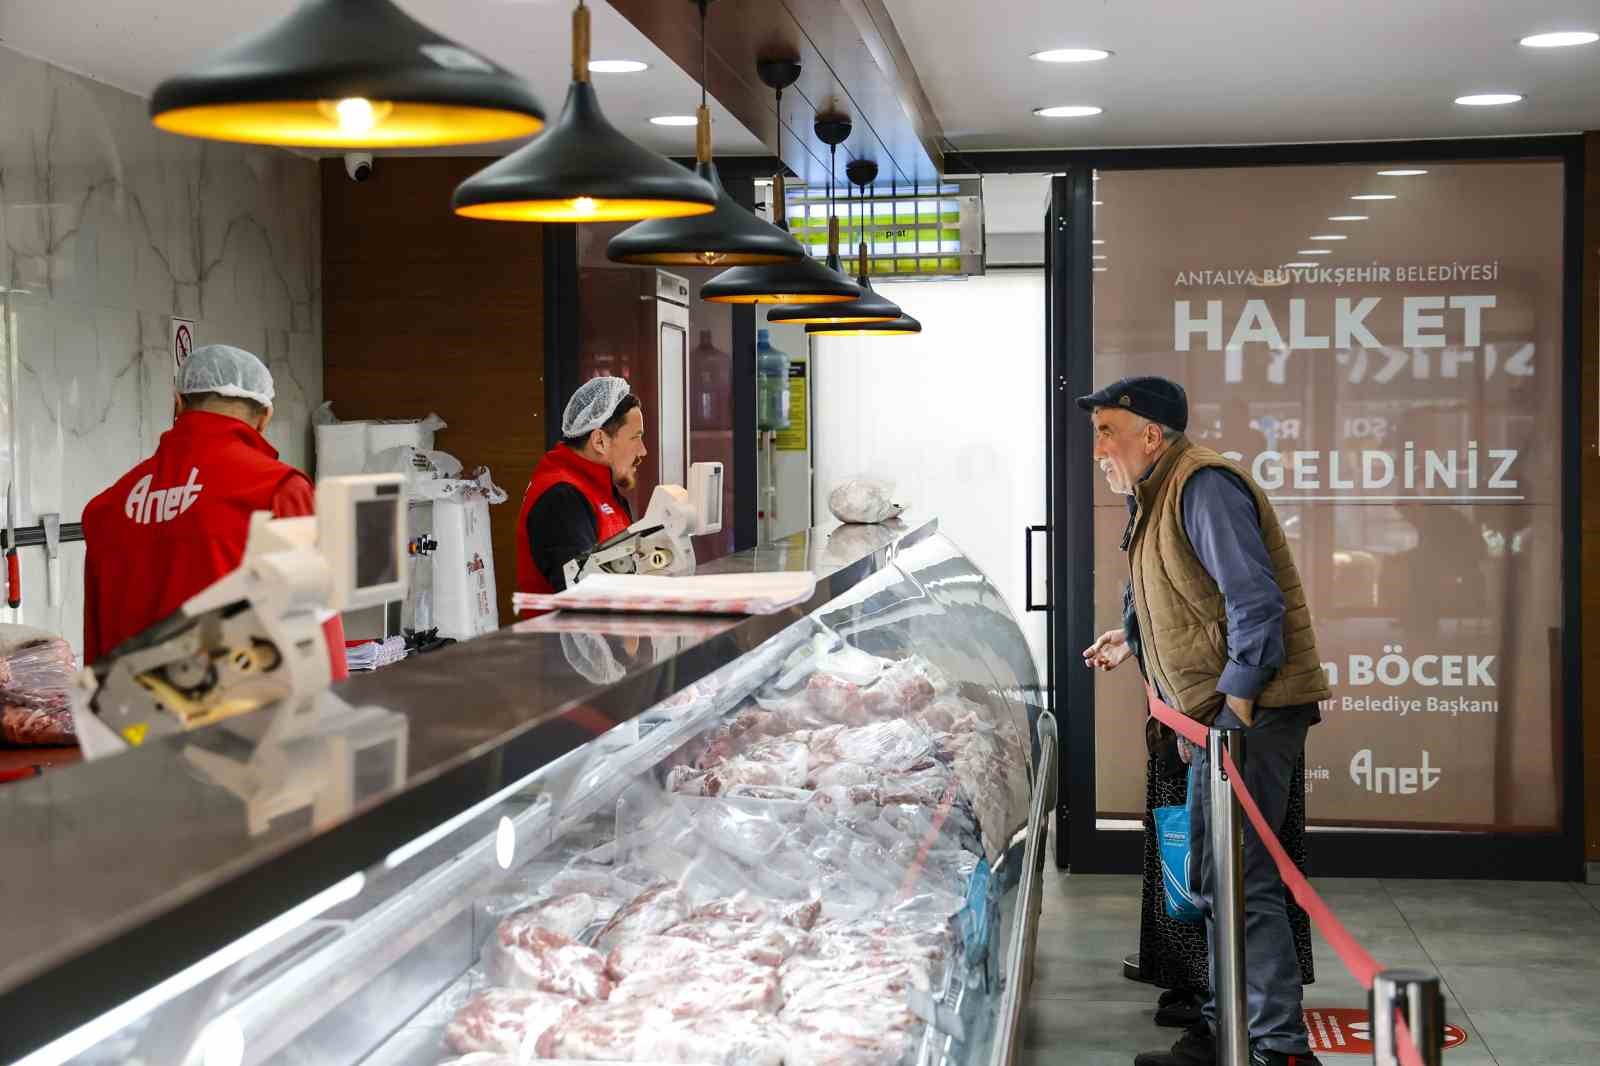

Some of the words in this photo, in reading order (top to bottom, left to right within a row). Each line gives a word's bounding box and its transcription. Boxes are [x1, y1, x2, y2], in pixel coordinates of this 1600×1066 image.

[1174, 269, 1257, 286] ANTALYA
[1263, 261, 1391, 287] BÜYÜKŞEHİR
[1396, 261, 1499, 282] BELEDİYESİ
[1174, 297, 1382, 351] HALK
[1403, 295, 1497, 348] ET
[1220, 440, 1519, 490] GELDİNİZ
[125, 466, 204, 525] Anet
[1348, 644, 1497, 687] BÖCEK
[1341, 696, 1422, 716] Belediye
[1426, 696, 1499, 717] Başkanı
[1349, 748, 1442, 795] Anet
